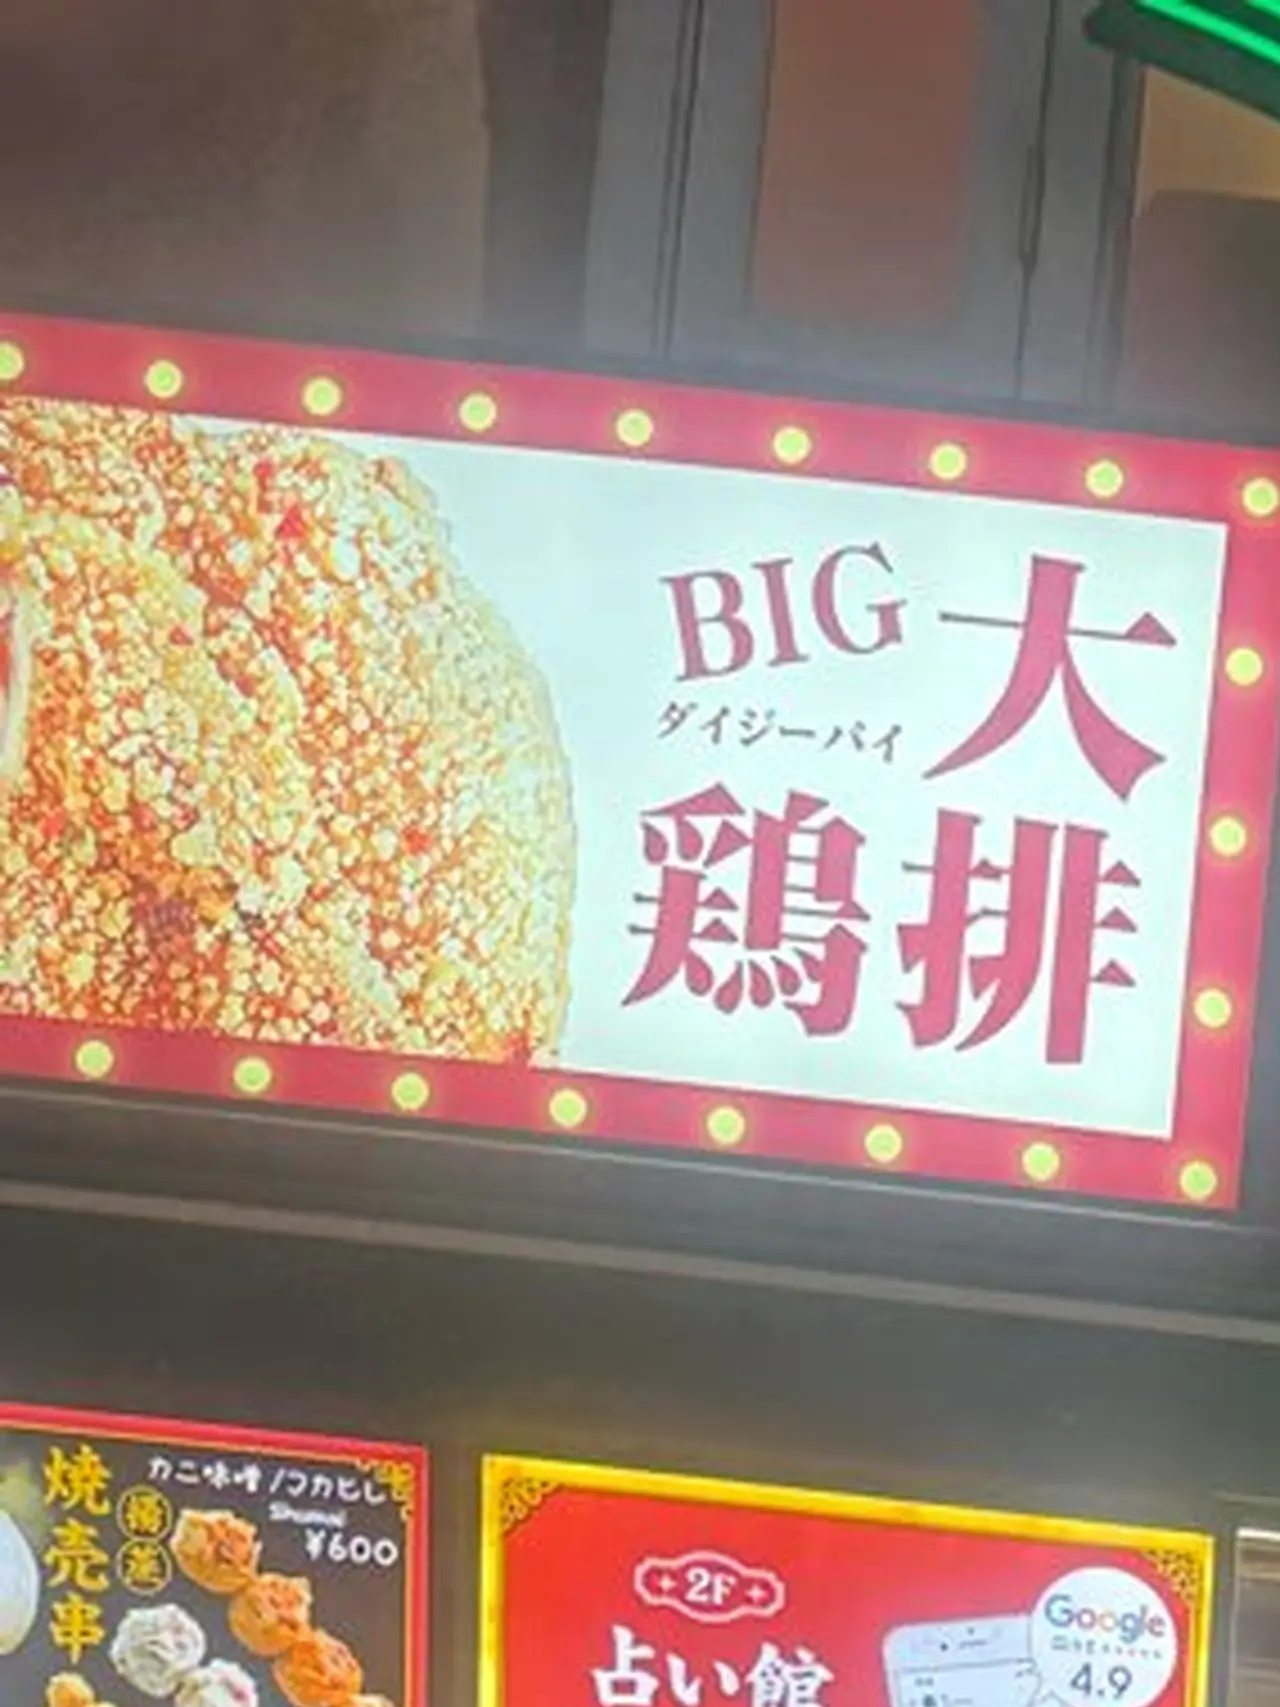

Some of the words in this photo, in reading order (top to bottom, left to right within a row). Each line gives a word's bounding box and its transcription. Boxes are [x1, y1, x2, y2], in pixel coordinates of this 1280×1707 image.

[660, 542, 904, 682] BIG
[922, 553, 1178, 801] 大
[657, 699, 904, 765] ダイジーパイ
[305, 1528, 399, 1566] ¥600
[684, 1571, 736, 1606] 2F
[1044, 1594, 1166, 1644] Google
[1070, 1661, 1133, 1700] 4.9
